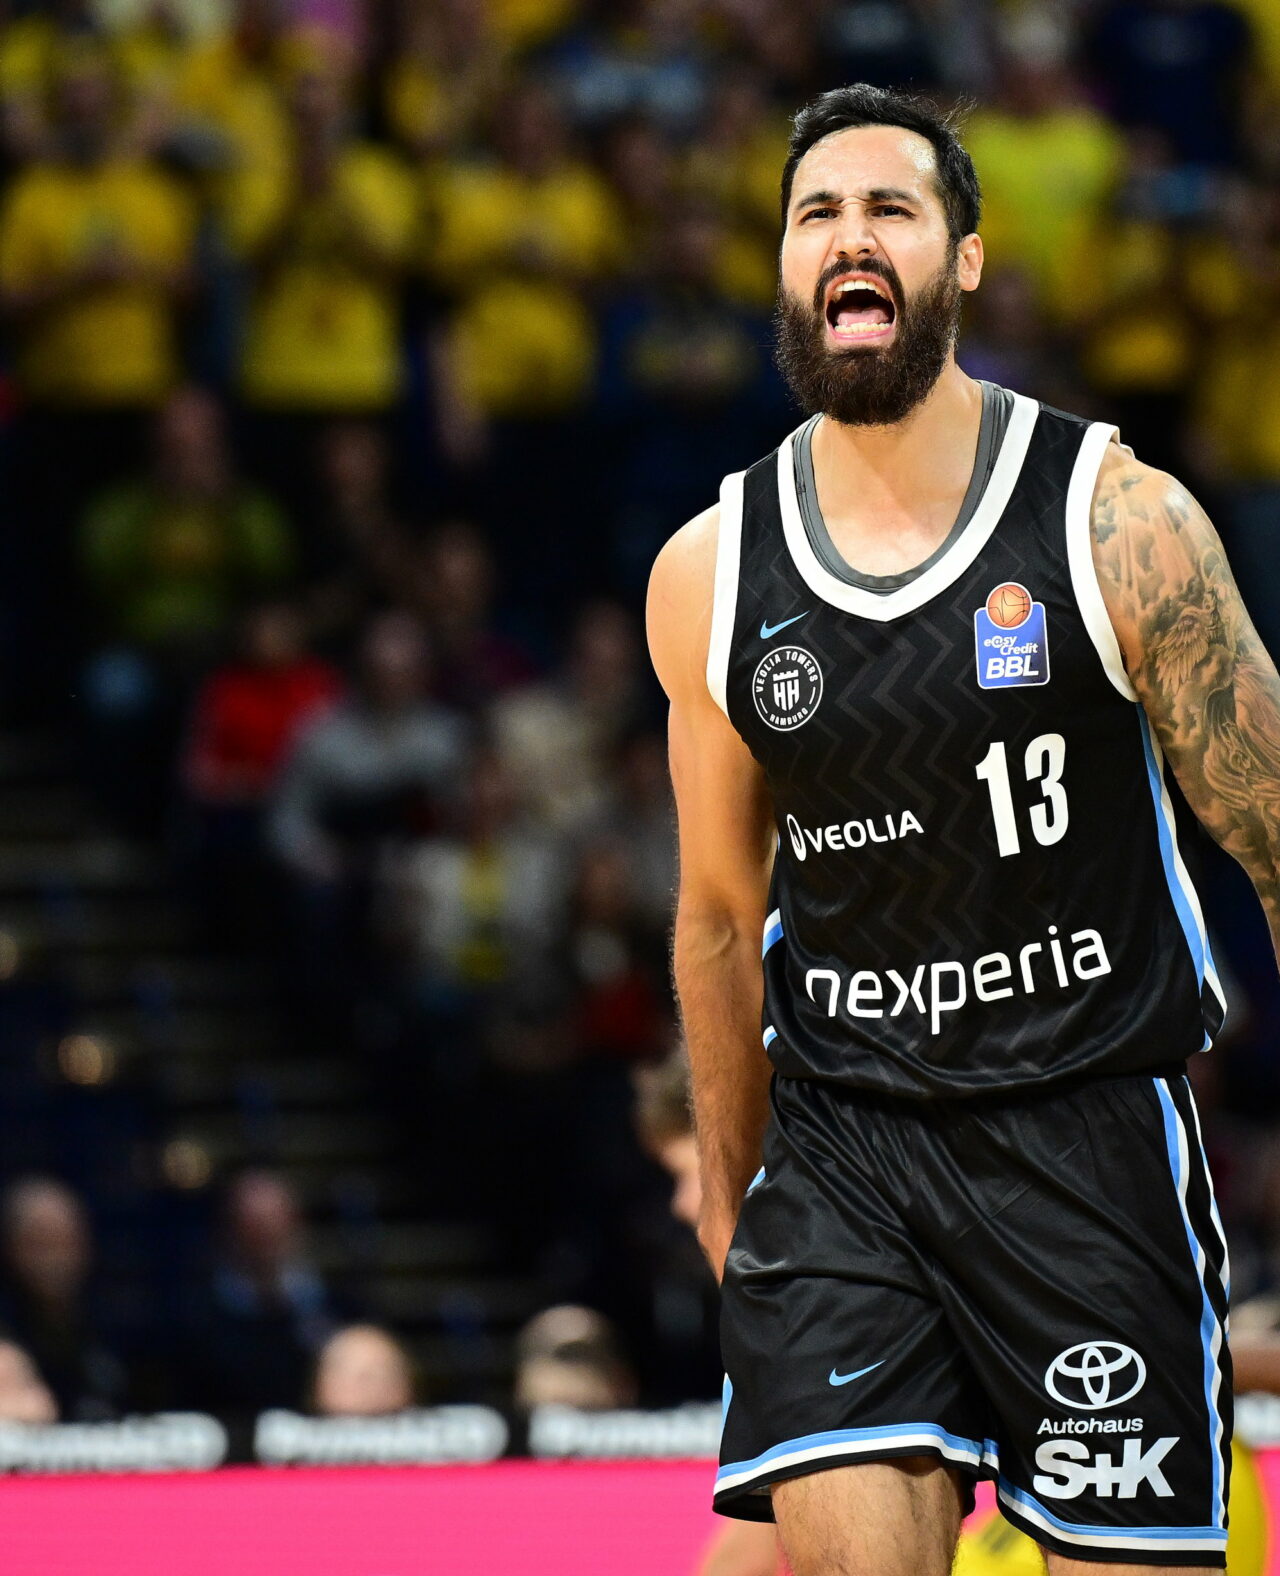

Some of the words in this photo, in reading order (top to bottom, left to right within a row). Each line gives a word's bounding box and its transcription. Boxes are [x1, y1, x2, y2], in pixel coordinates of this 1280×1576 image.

[985, 655, 1040, 680] BBL
[1000, 642, 1039, 656] Credit
[755, 653, 782, 693] VEOLIA
[785, 650, 819, 683] TOWERS
[769, 707, 809, 726] HAMBURG
[975, 732, 1070, 858] 13
[803, 810, 925, 854] VEOLIA
[805, 925, 1113, 1035] nexperia
[1036, 1417, 1145, 1436] Autohaus
[1032, 1436, 1181, 1500] S+K
